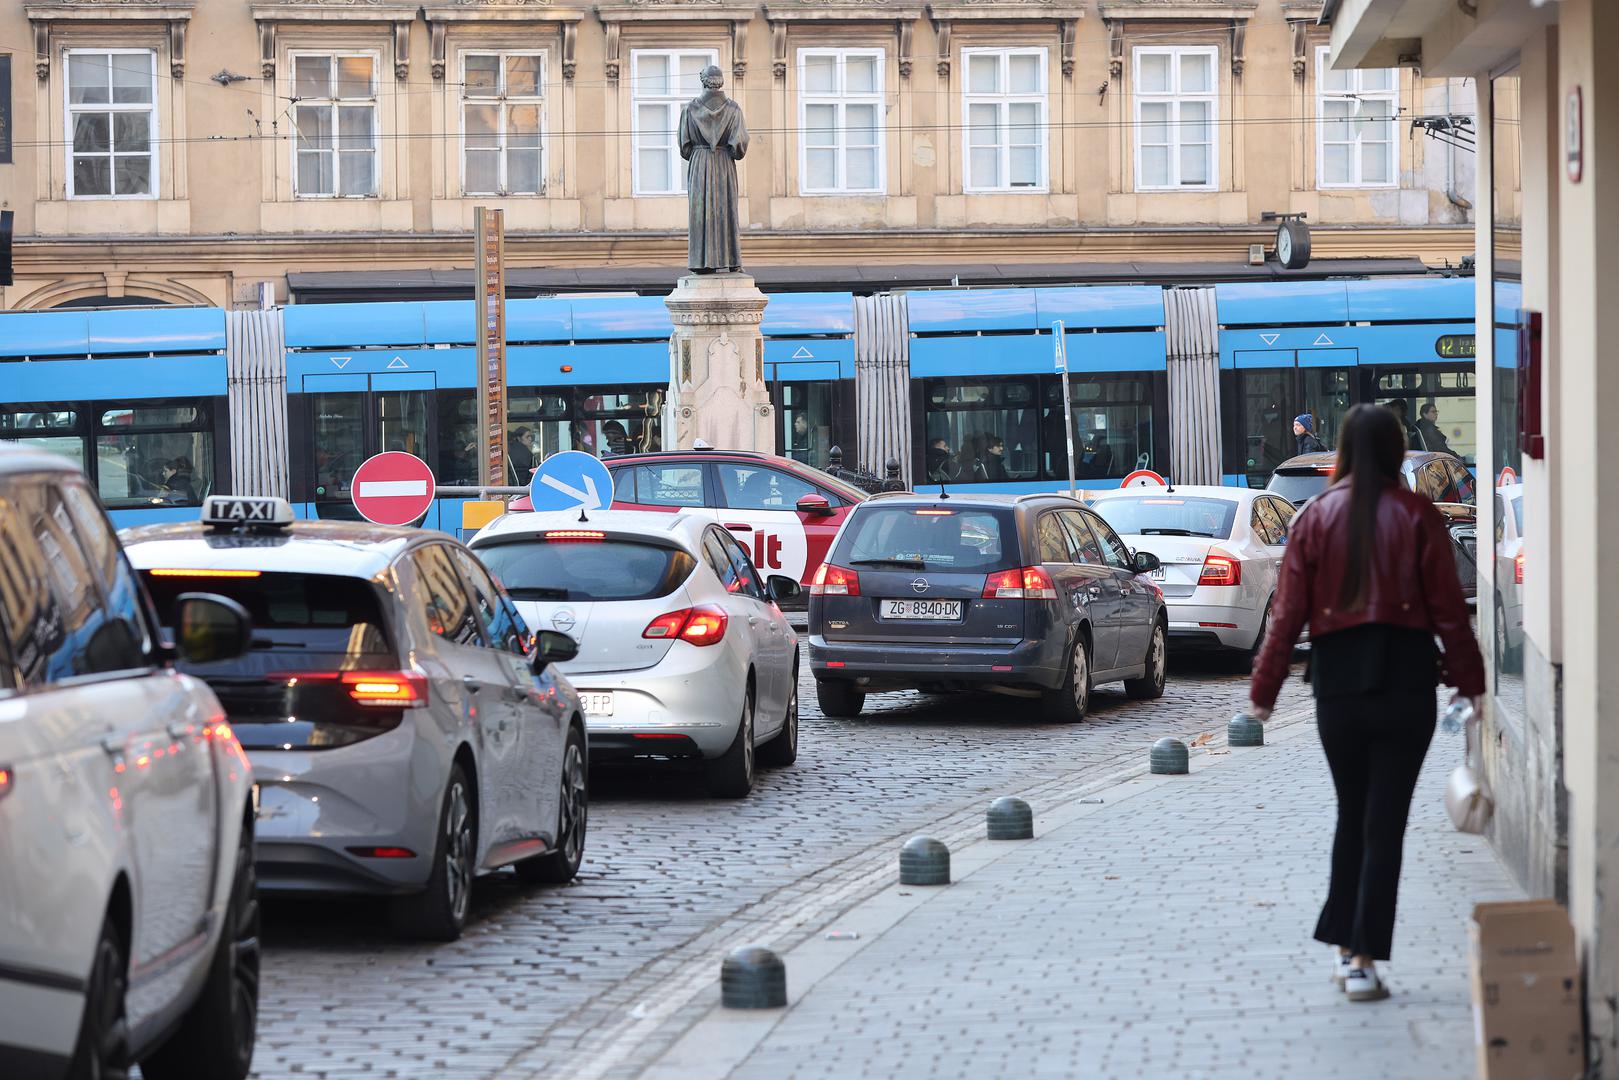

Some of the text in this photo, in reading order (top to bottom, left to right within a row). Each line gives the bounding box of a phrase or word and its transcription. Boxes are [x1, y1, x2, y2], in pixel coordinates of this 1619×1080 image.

[1441, 337, 1454, 355] 12
[213, 501, 274, 519] TAXI
[889, 601, 905, 615] ZG
